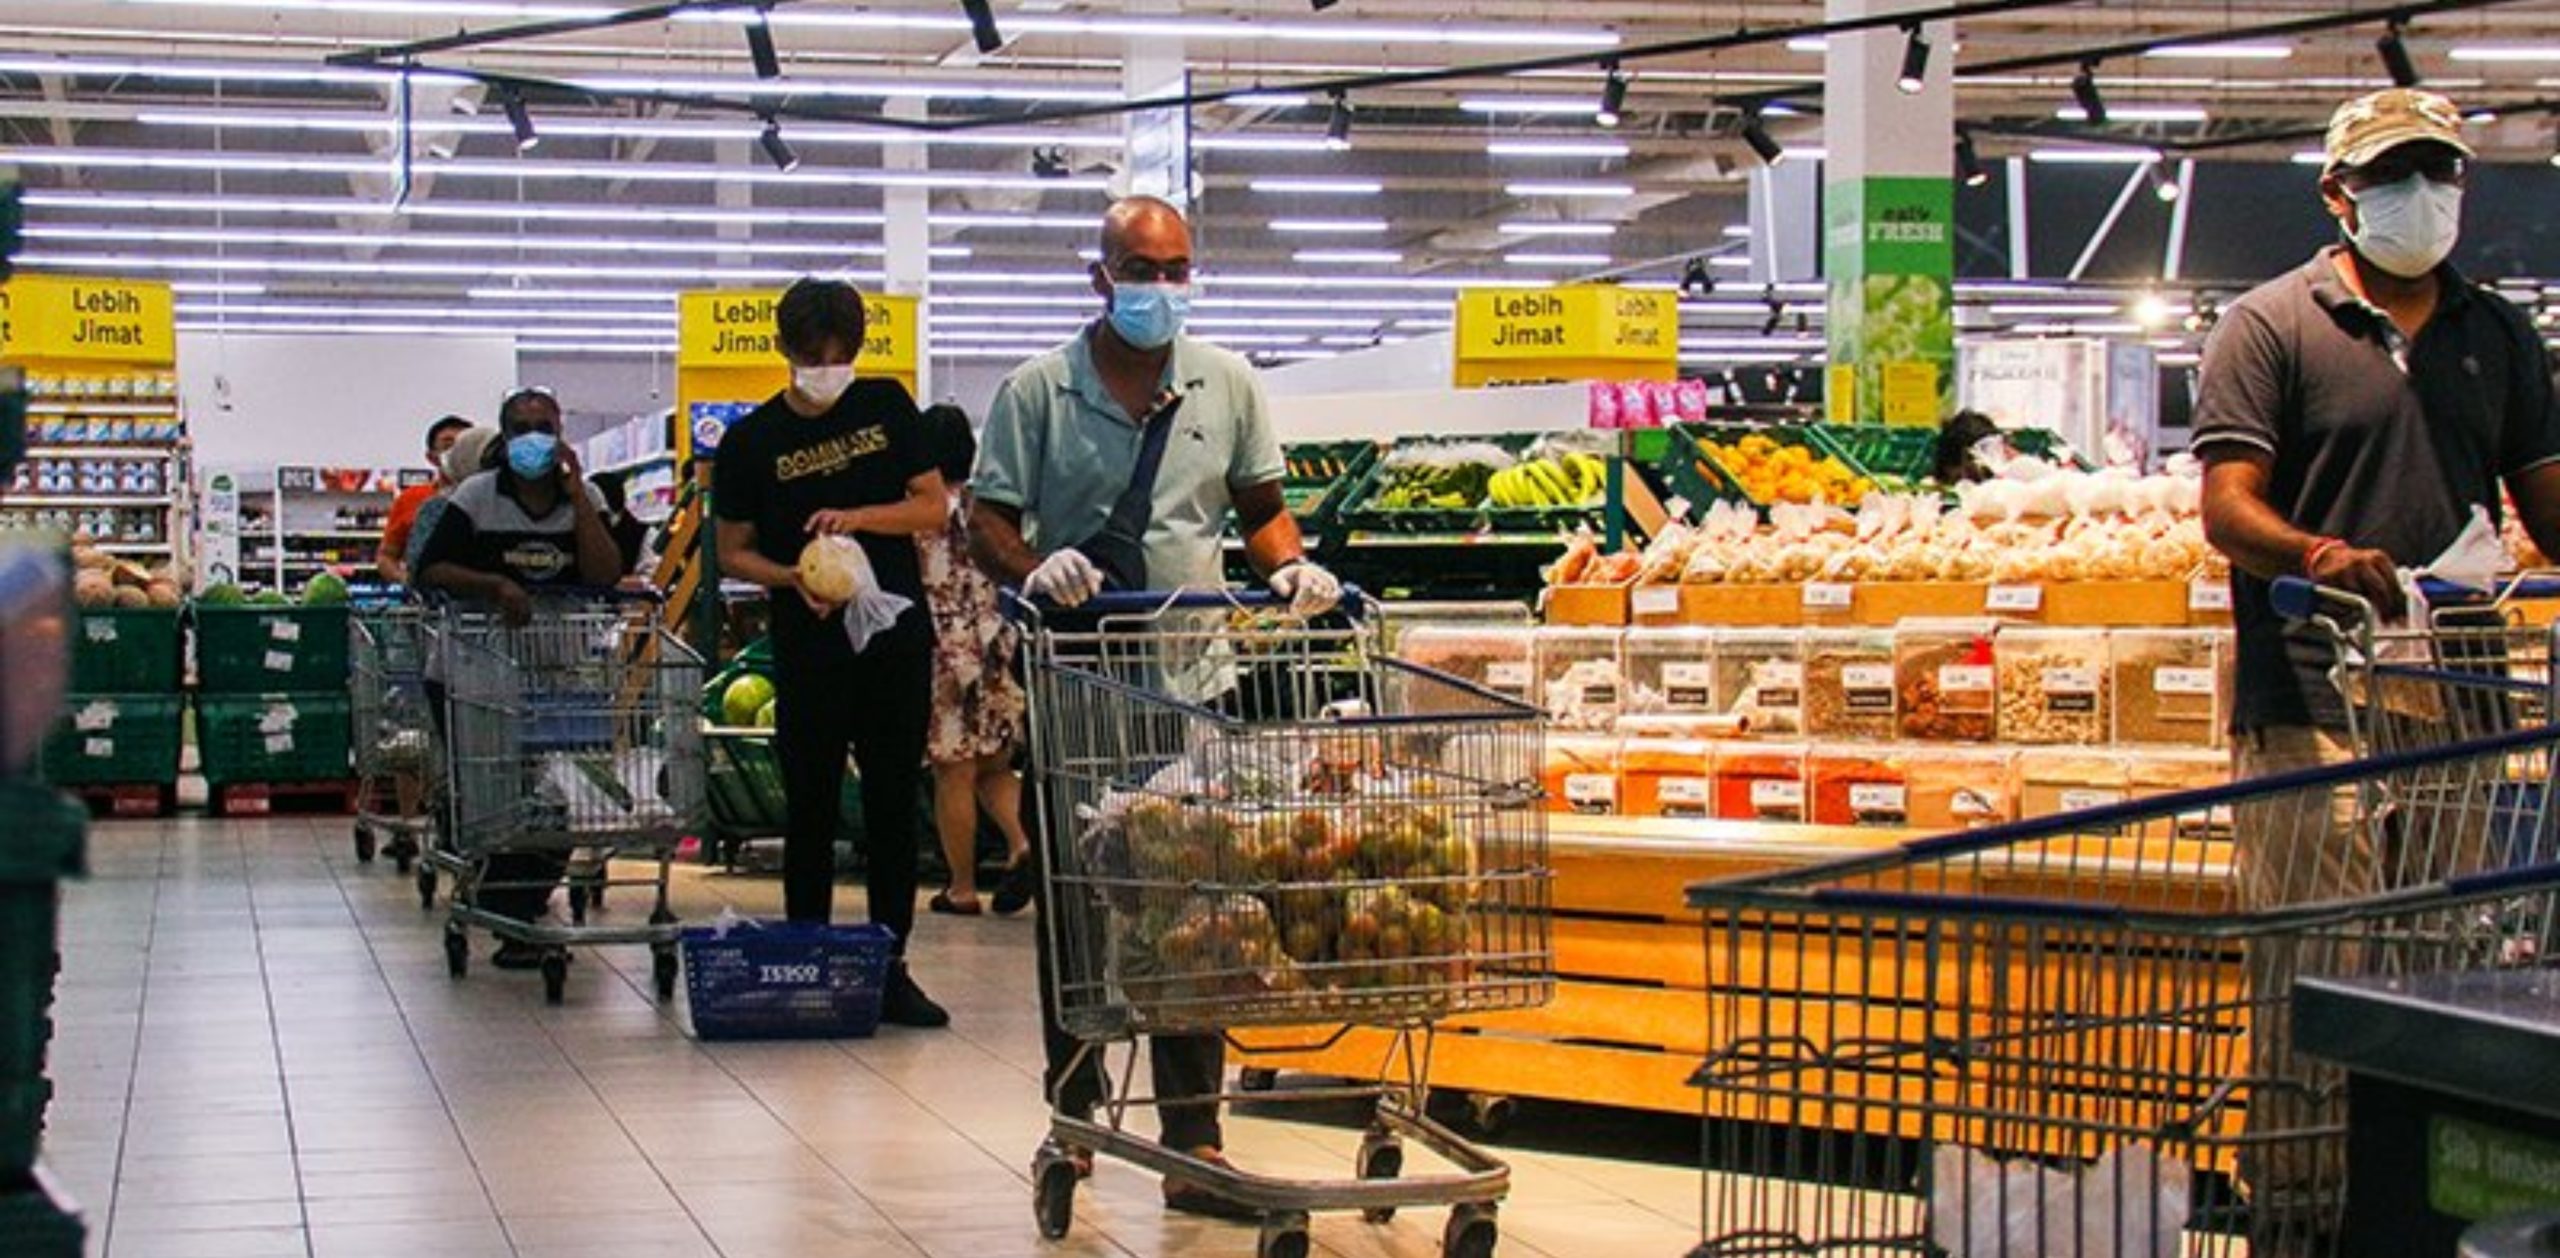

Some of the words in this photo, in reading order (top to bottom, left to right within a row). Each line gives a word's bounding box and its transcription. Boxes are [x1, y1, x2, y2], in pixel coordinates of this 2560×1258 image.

[72, 288, 141, 313] Lebih
[1493, 294, 1563, 317] Lebih
[1616, 296, 1659, 317] Lebih
[72, 318, 143, 345] Jimat
[1492, 325, 1565, 346] Jimat
[1616, 323, 1659, 346] Jimat
